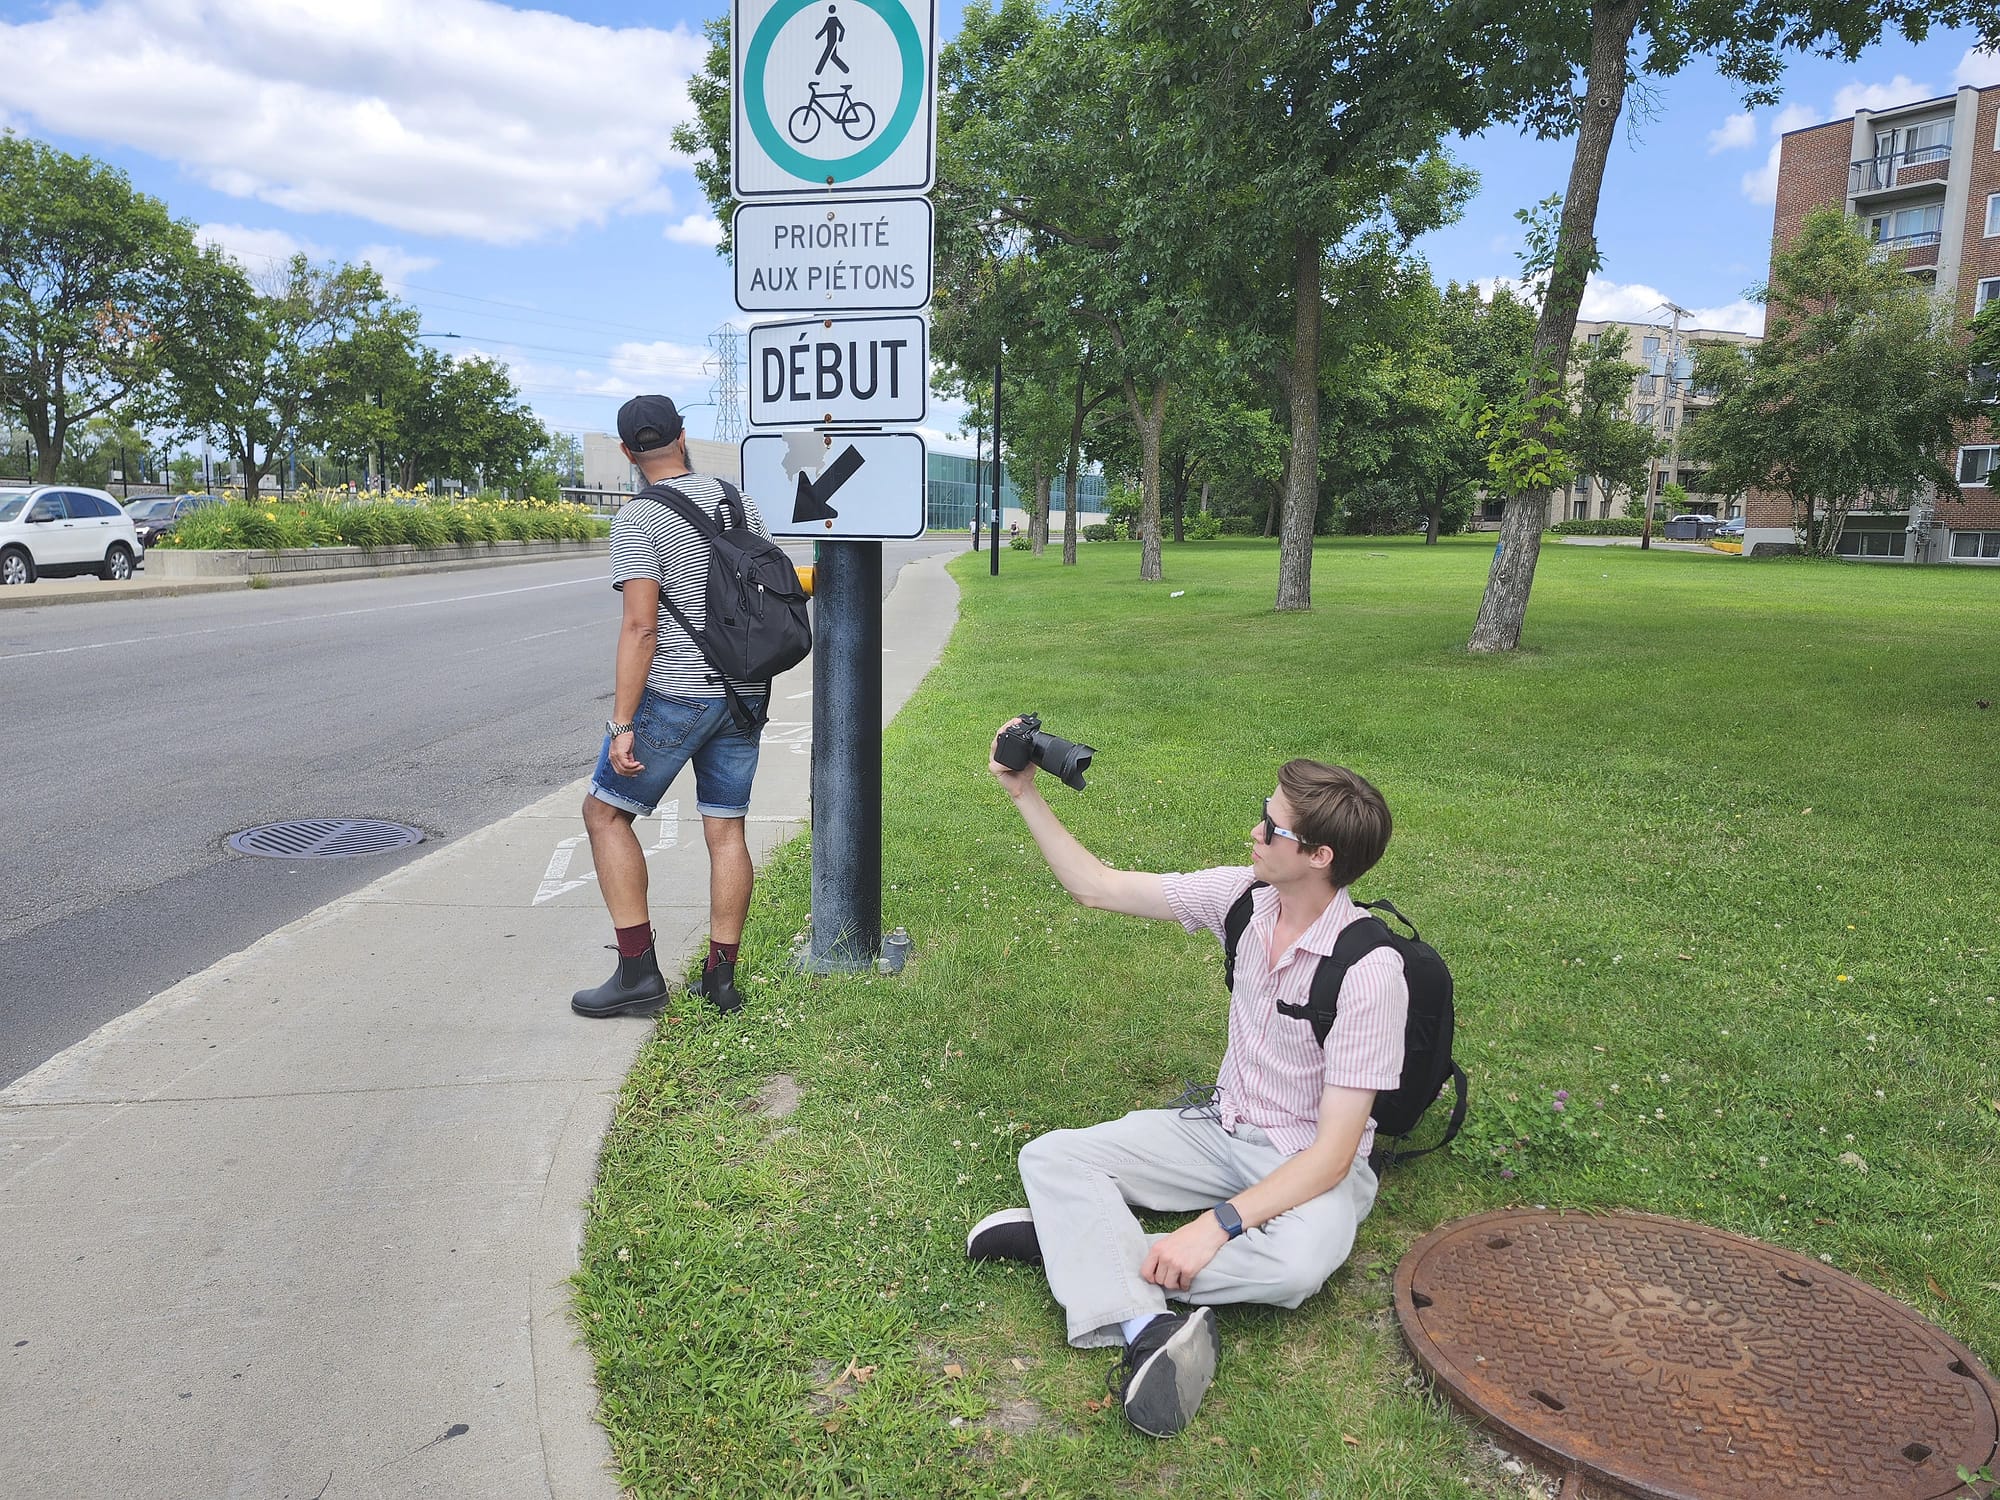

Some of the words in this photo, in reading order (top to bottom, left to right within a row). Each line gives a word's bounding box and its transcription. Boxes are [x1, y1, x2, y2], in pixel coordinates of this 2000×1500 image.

[774, 216, 889, 250] PRIORITÉ
[750, 266, 799, 292] AUX
[808, 260, 915, 291] PIÉTONS
[762, 332, 908, 404] DÉBUT
